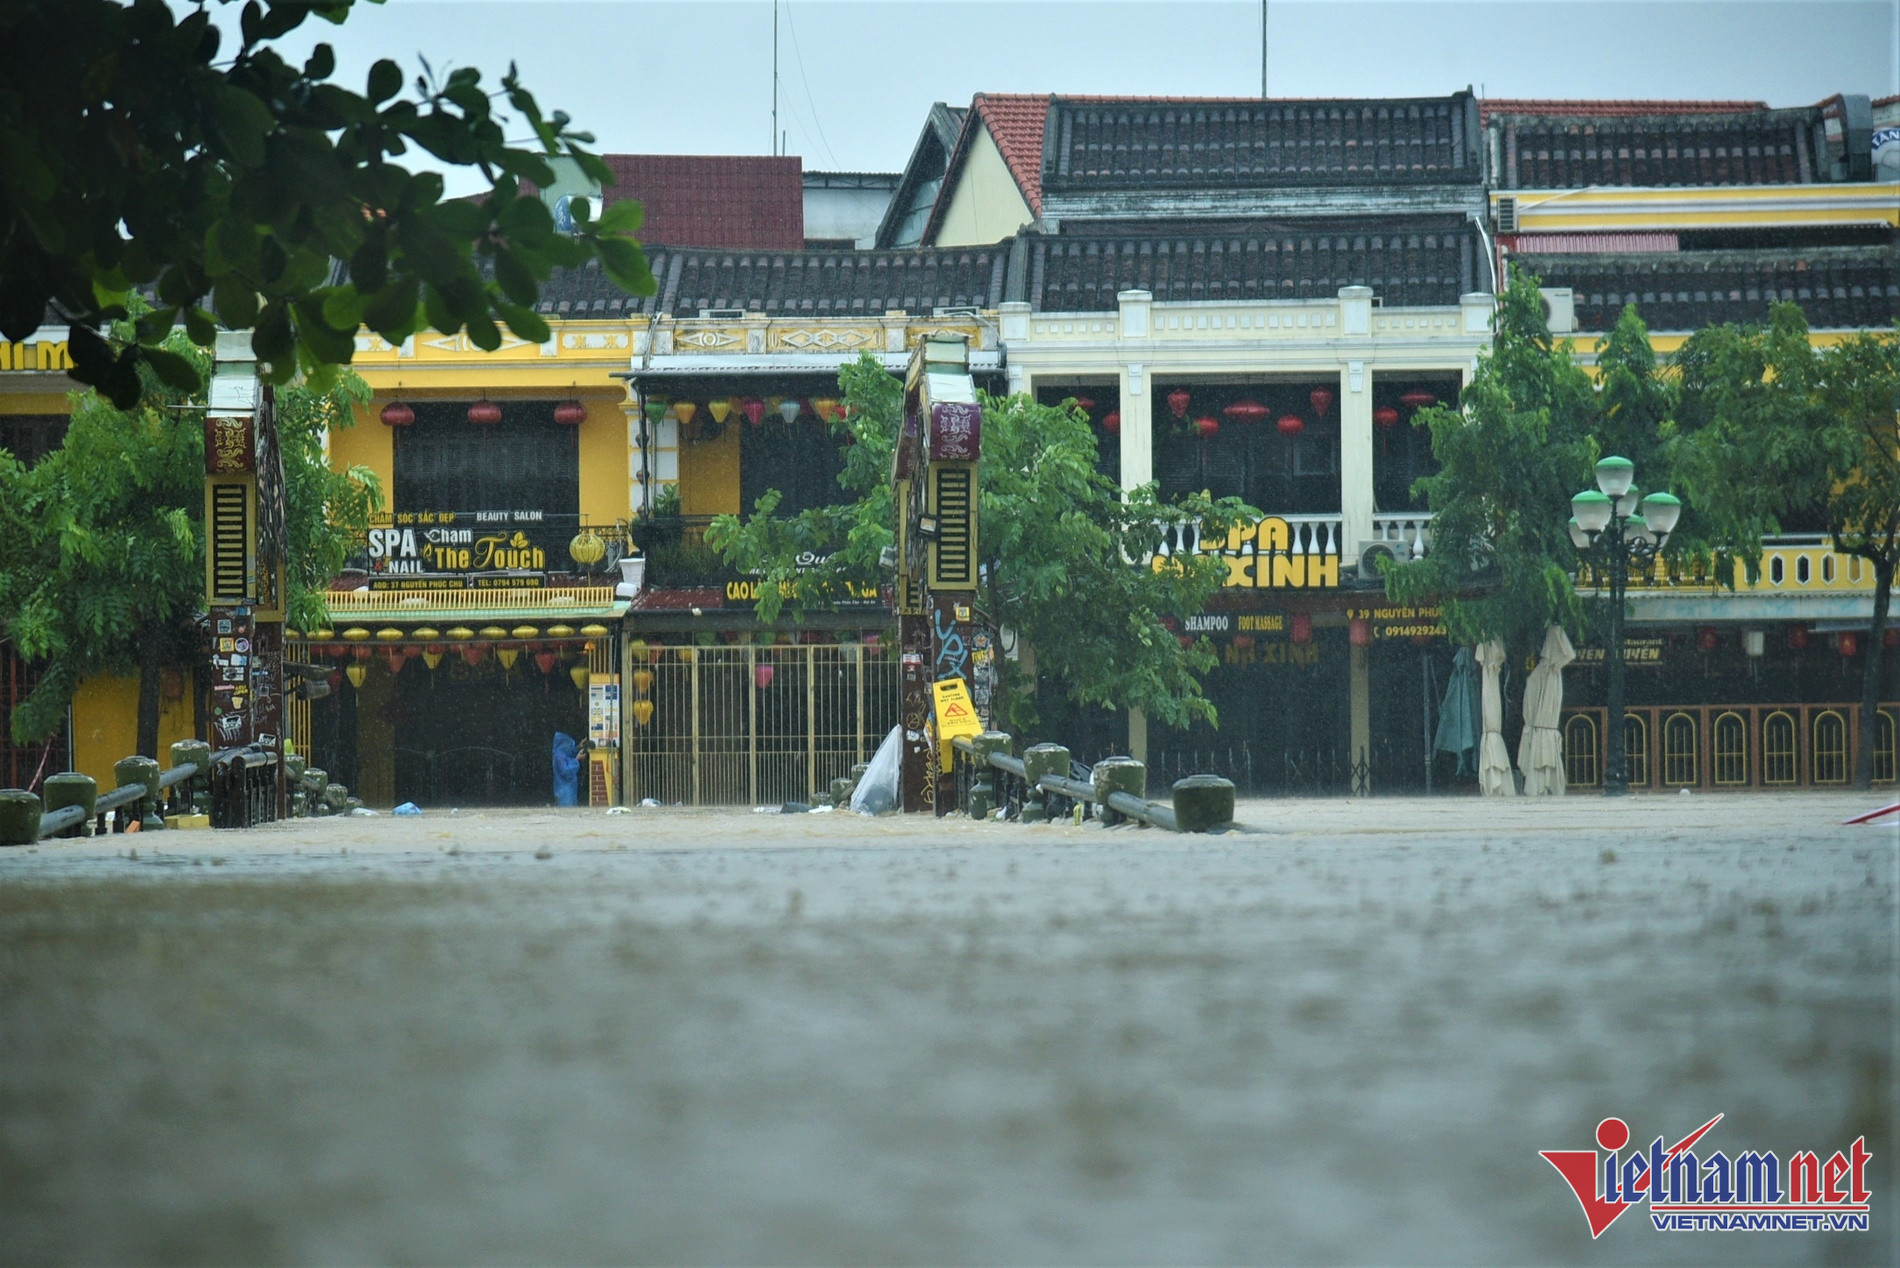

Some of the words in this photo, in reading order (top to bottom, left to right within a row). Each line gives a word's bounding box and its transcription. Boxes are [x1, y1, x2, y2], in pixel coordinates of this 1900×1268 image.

[476, 511, 509, 521] BEAUTY
[514, 510, 543, 520] SALON
[368, 528, 417, 558] SPA
[434, 547, 470, 569] The
[473, 531, 545, 570] Touch
[389, 560, 424, 574] NAIL
[1223, 554, 1339, 588] XINH
[391, 581, 399, 589] 37
[449, 580, 464, 588] CHU
[478, 579, 492, 587] TEL:
[727, 581, 748, 600] CAO
[1358, 609, 1370, 619] 39
[1185, 615, 1229, 630] SHAMPOO
[1238, 615, 1254, 630] FOOT
[1255, 615, 1284, 630] MASSAGE
